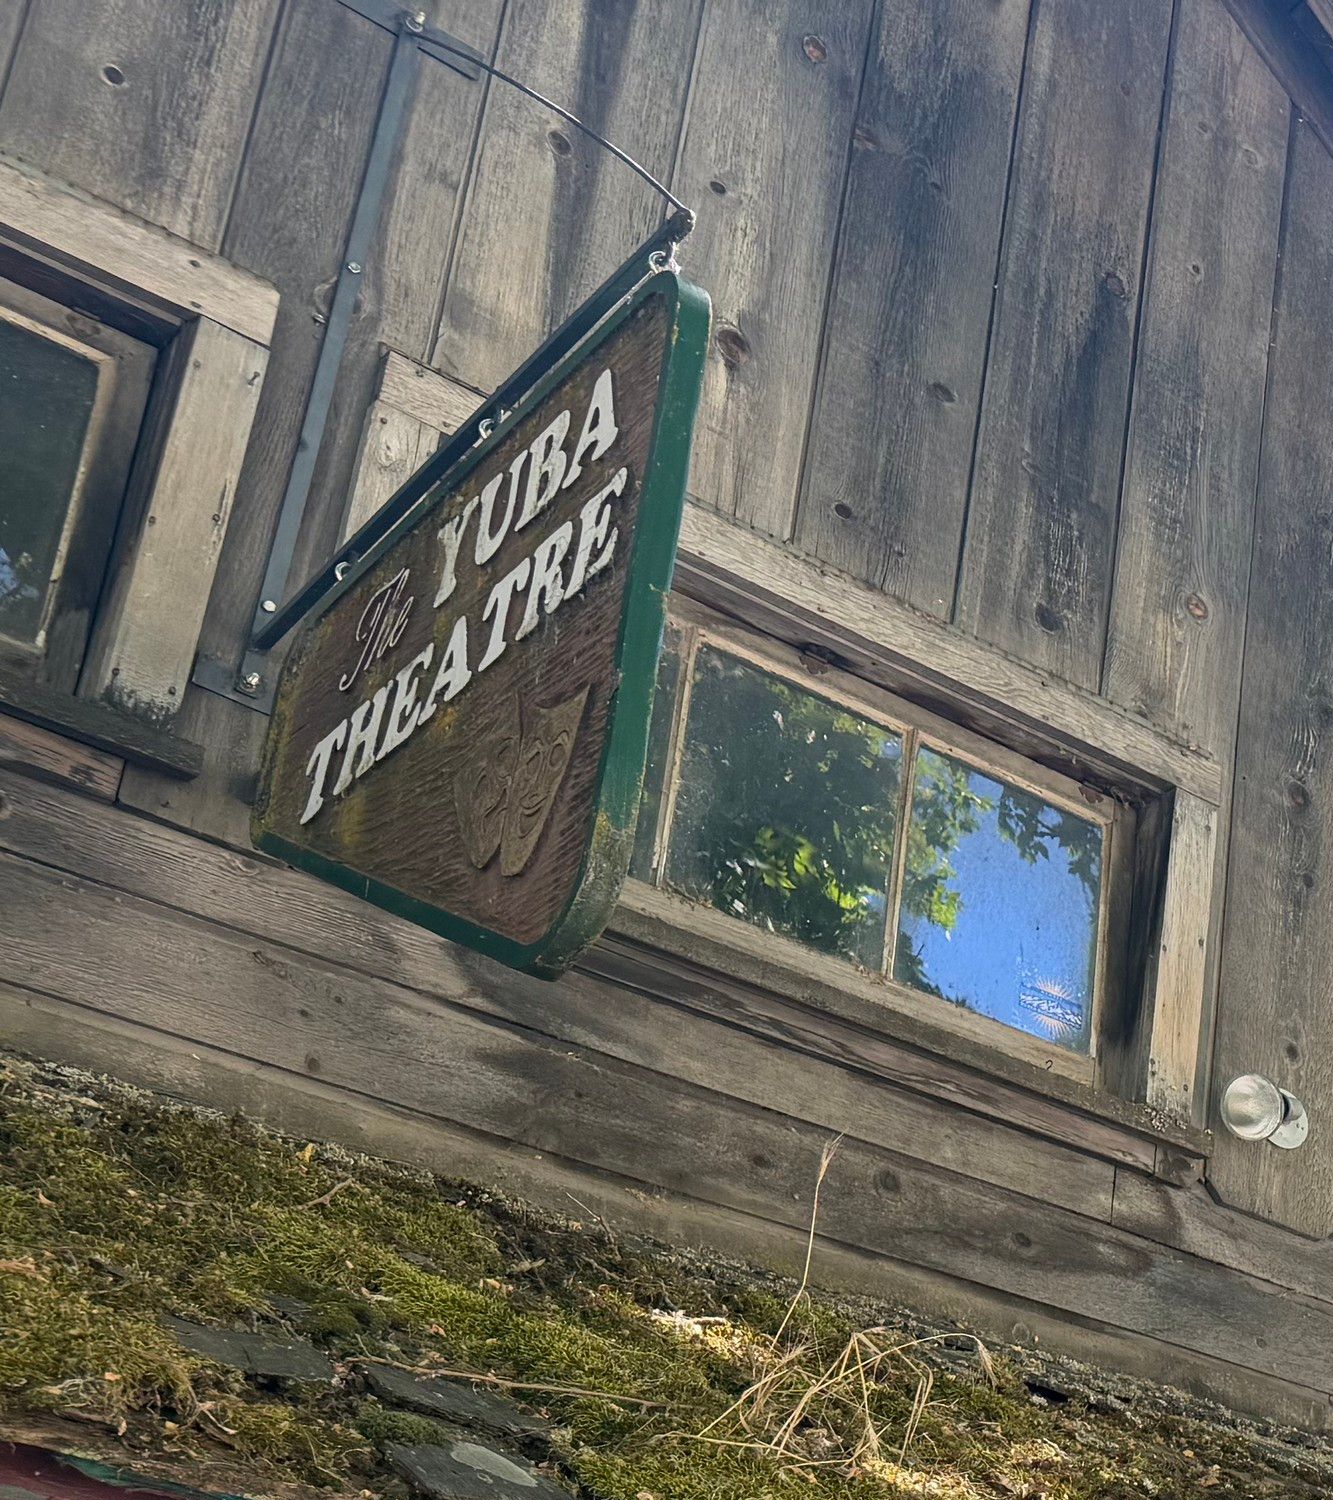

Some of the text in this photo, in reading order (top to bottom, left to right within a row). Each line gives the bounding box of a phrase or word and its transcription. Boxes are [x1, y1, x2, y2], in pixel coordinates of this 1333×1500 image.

[299, 467, 630, 825] THEATRE
[338, 367, 620, 692] The YUBA
